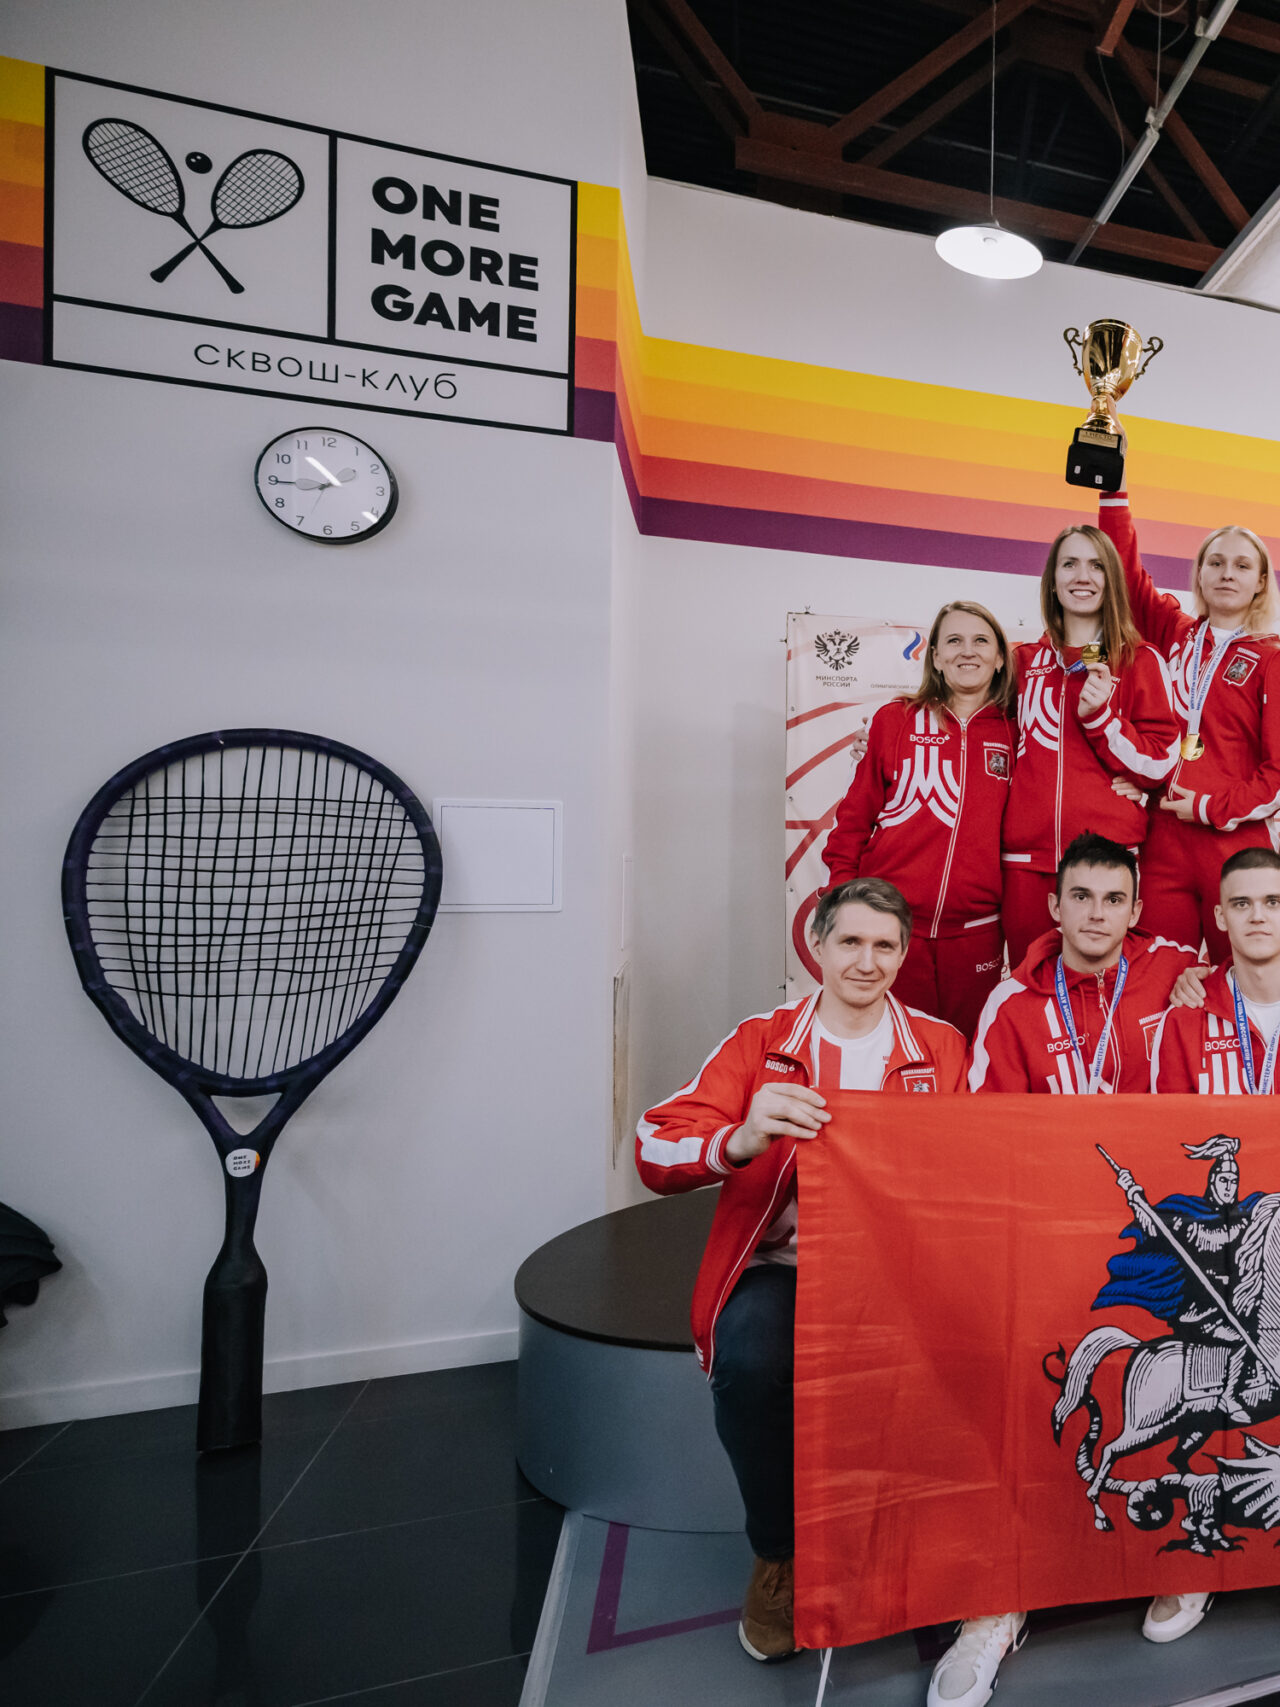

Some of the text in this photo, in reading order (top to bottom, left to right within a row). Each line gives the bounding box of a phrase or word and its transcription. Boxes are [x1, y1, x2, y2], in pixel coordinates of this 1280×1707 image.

[372, 176, 500, 233] ONE
[371, 227, 539, 291] MORE
[371, 283, 537, 343] GAME
[296, 439, 309, 450] 11
[321, 437, 337, 448] 12
[354, 446, 359, 457] 1
[275, 453, 292, 465] 10
[369, 463, 380, 475] 2
[267, 474, 279, 486] 9
[375, 486, 385, 497] 3
[274, 497, 285, 509] 8
[295, 515, 305, 526] 7
[350, 520, 361, 532] 5
[322, 525, 333, 536] 6
[909, 734, 945, 745] BOSCO
[1205, 1039, 1241, 1051] BOSCO
[765, 1060, 788, 1073] BOSCO
